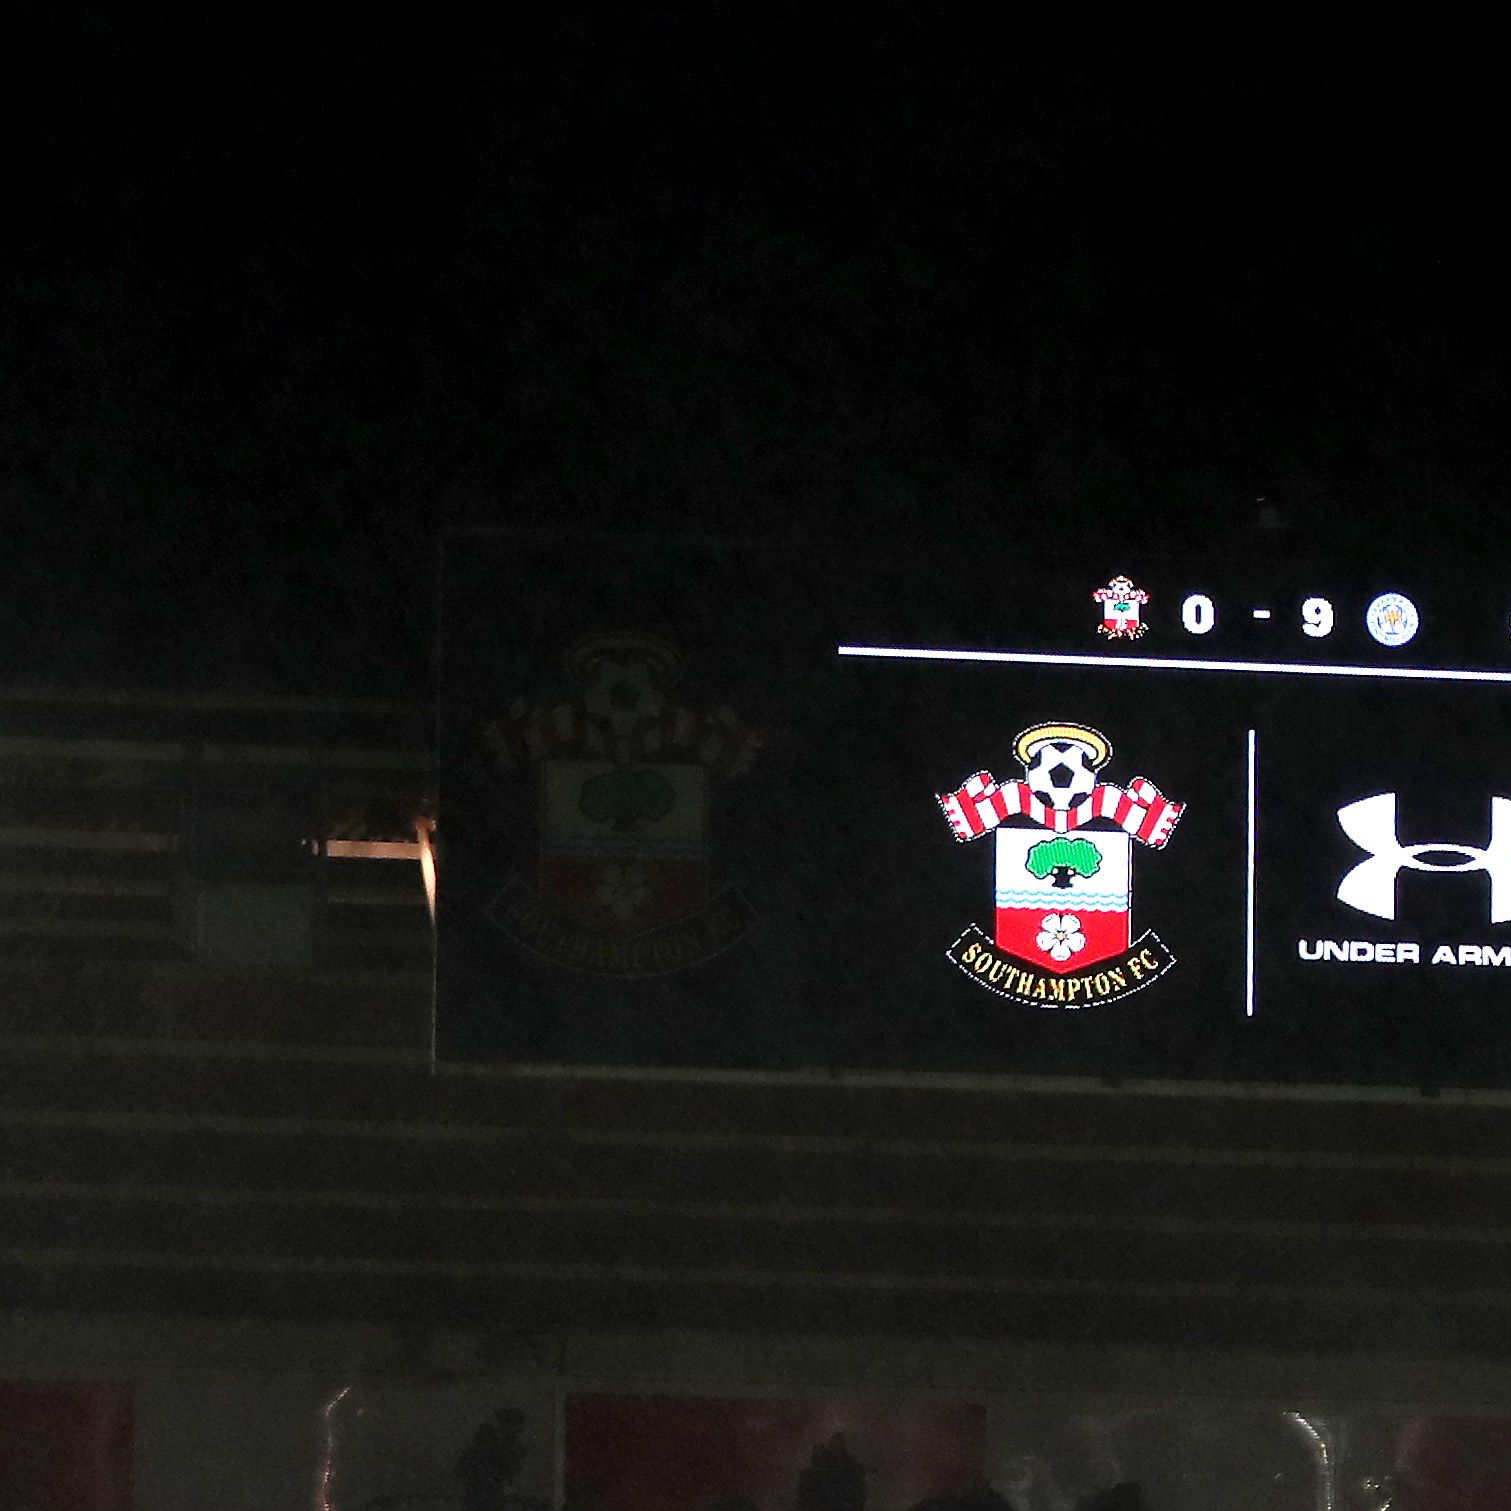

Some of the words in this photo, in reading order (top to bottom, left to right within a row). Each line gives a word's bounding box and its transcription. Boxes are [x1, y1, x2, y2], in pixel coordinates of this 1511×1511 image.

[1182, 594, 1215, 635] 0
[1302, 597, 1334, 638] 9
[961, 942, 1127, 1002] SOUTHAMPTON
[1127, 949, 1159, 980] FC
[1298, 939, 1420, 964] UNDER
